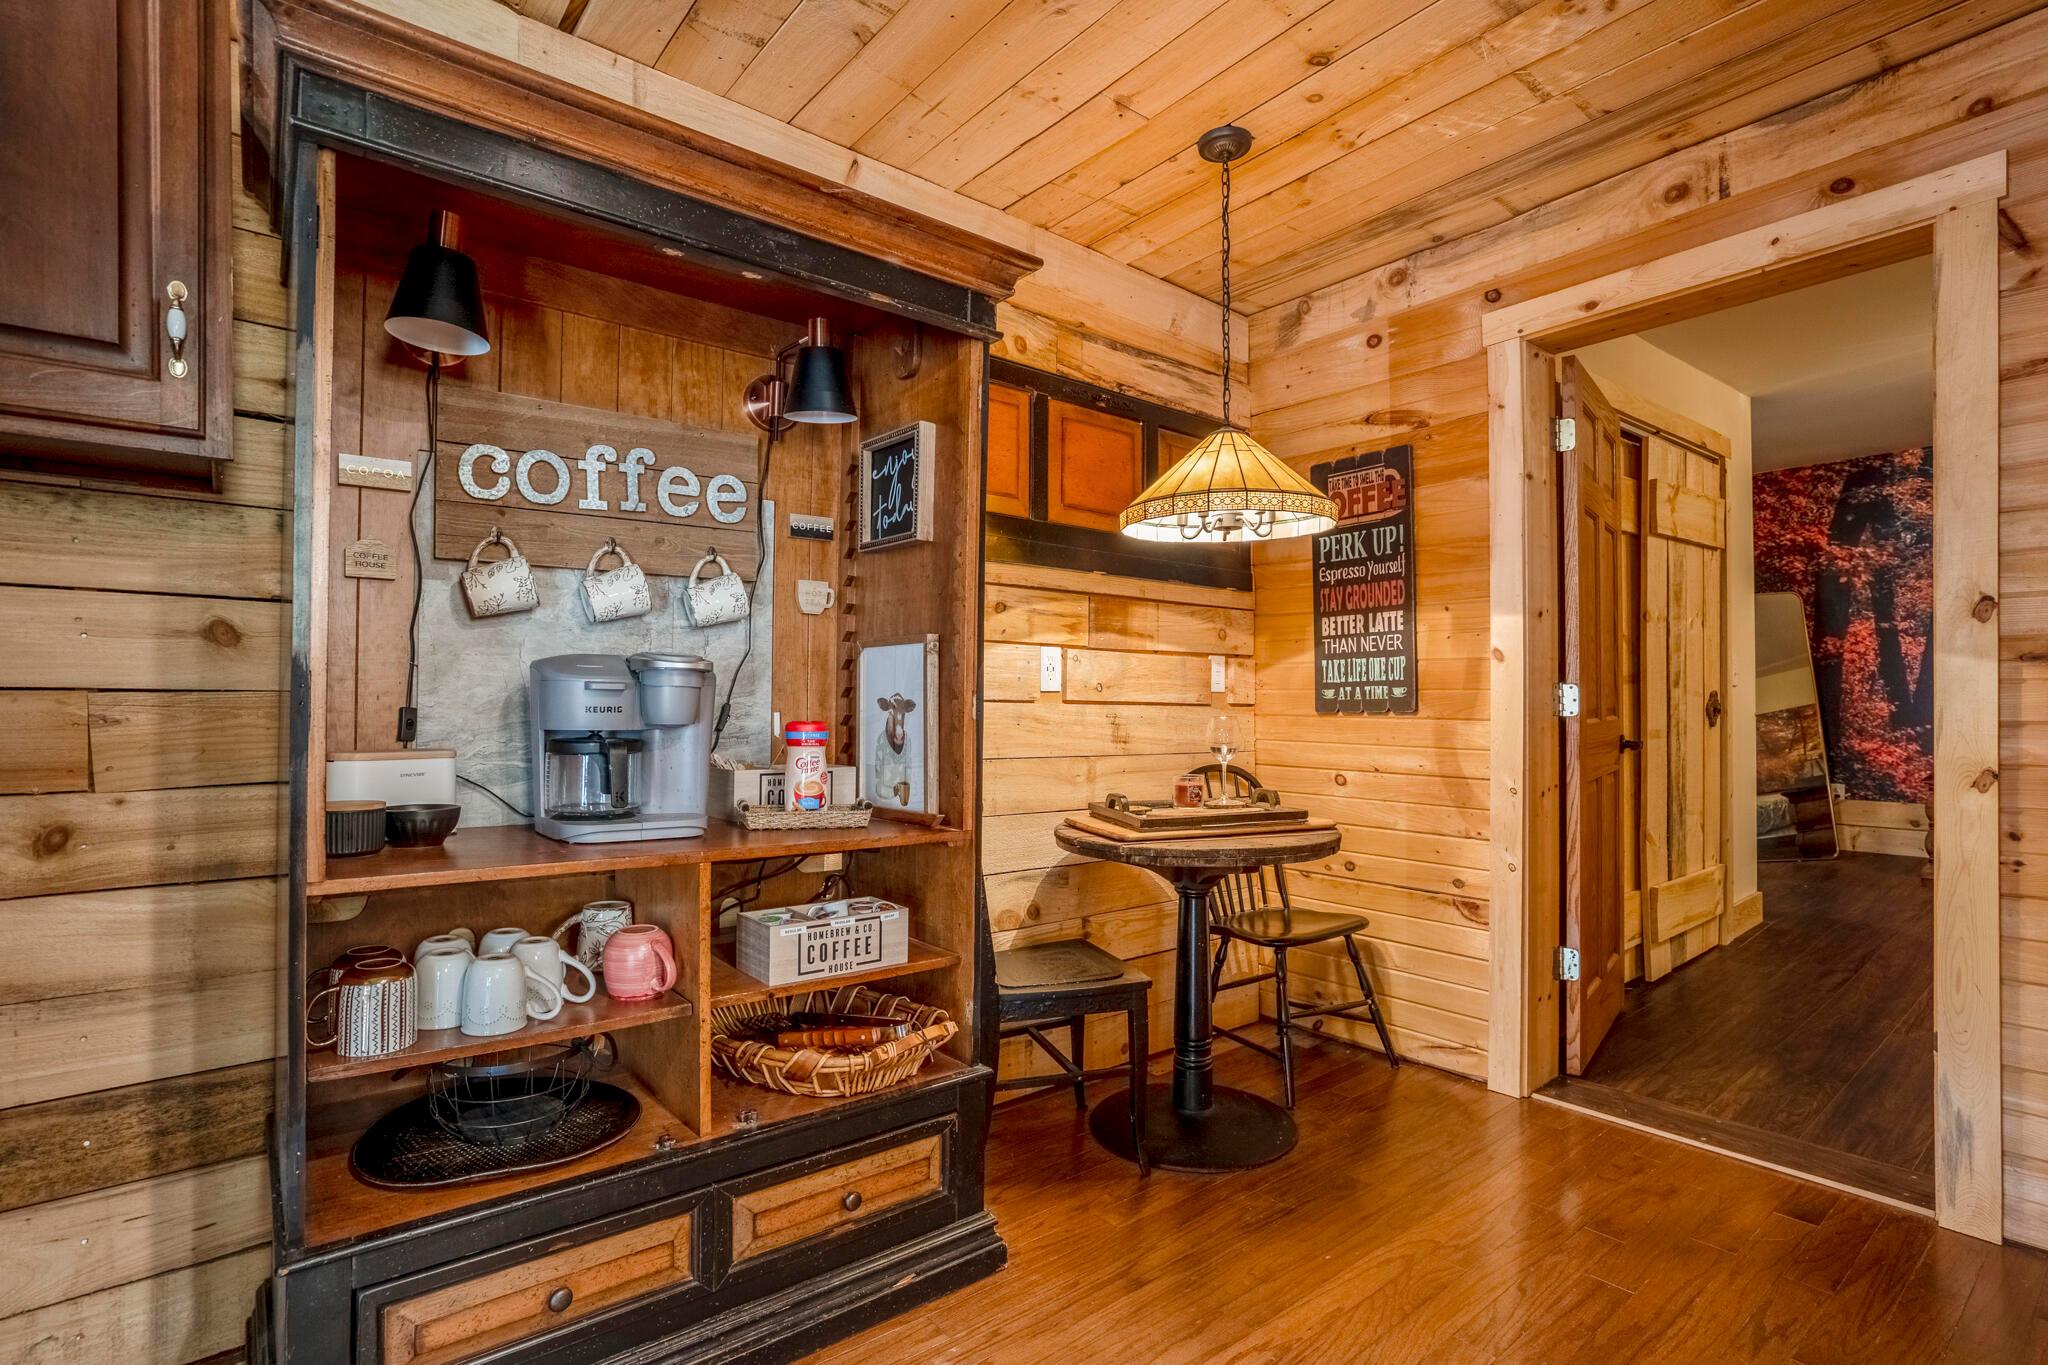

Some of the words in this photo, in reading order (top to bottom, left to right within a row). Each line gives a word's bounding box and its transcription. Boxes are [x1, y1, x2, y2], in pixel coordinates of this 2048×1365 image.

[458, 444, 747, 524] coffee
[1329, 478, 1341, 492] TAKE
[1341, 475, 1352, 489] TIME
[1352, 473, 1359, 488] TO
[1374, 468, 1385, 482] THE
[792, 521, 832, 533] COFFEE
[1318, 530, 1368, 564] PERK
[1371, 524, 1404, 557] UP!
[352, 551, 389, 561] COFFEE
[354, 560, 386, 570] HOUSE
[1320, 565, 1366, 585] Espresso
[1367, 552, 1405, 580] Yourself
[1320, 586, 1343, 613] STAY
[1345, 579, 1406, 610] GROUNDED
[1321, 614, 1365, 637] BETTER
[1368, 610, 1404, 633] LATTE
[1321, 637, 1357, 655] THAN
[1360, 634, 1404, 652] NEVER
[1321, 659, 1346, 683] TAKE
[1347, 657, 1368, 682] LIFE
[1368, 657, 1387, 681] ONE
[1388, 656, 1406, 681] CUP
[1338, 686, 1352, 700] AT
[1354, 686, 1362, 700] A
[1364, 685, 1389, 700] TIME
[585, 705, 623, 714] KEURIG
[807, 926, 851, 942] HOMEBREW
[854, 924, 860, 935] &
[863, 922, 876, 933] CO.
[807, 935, 872, 965] COFFEE
[828, 960, 854, 974] HOUSE
